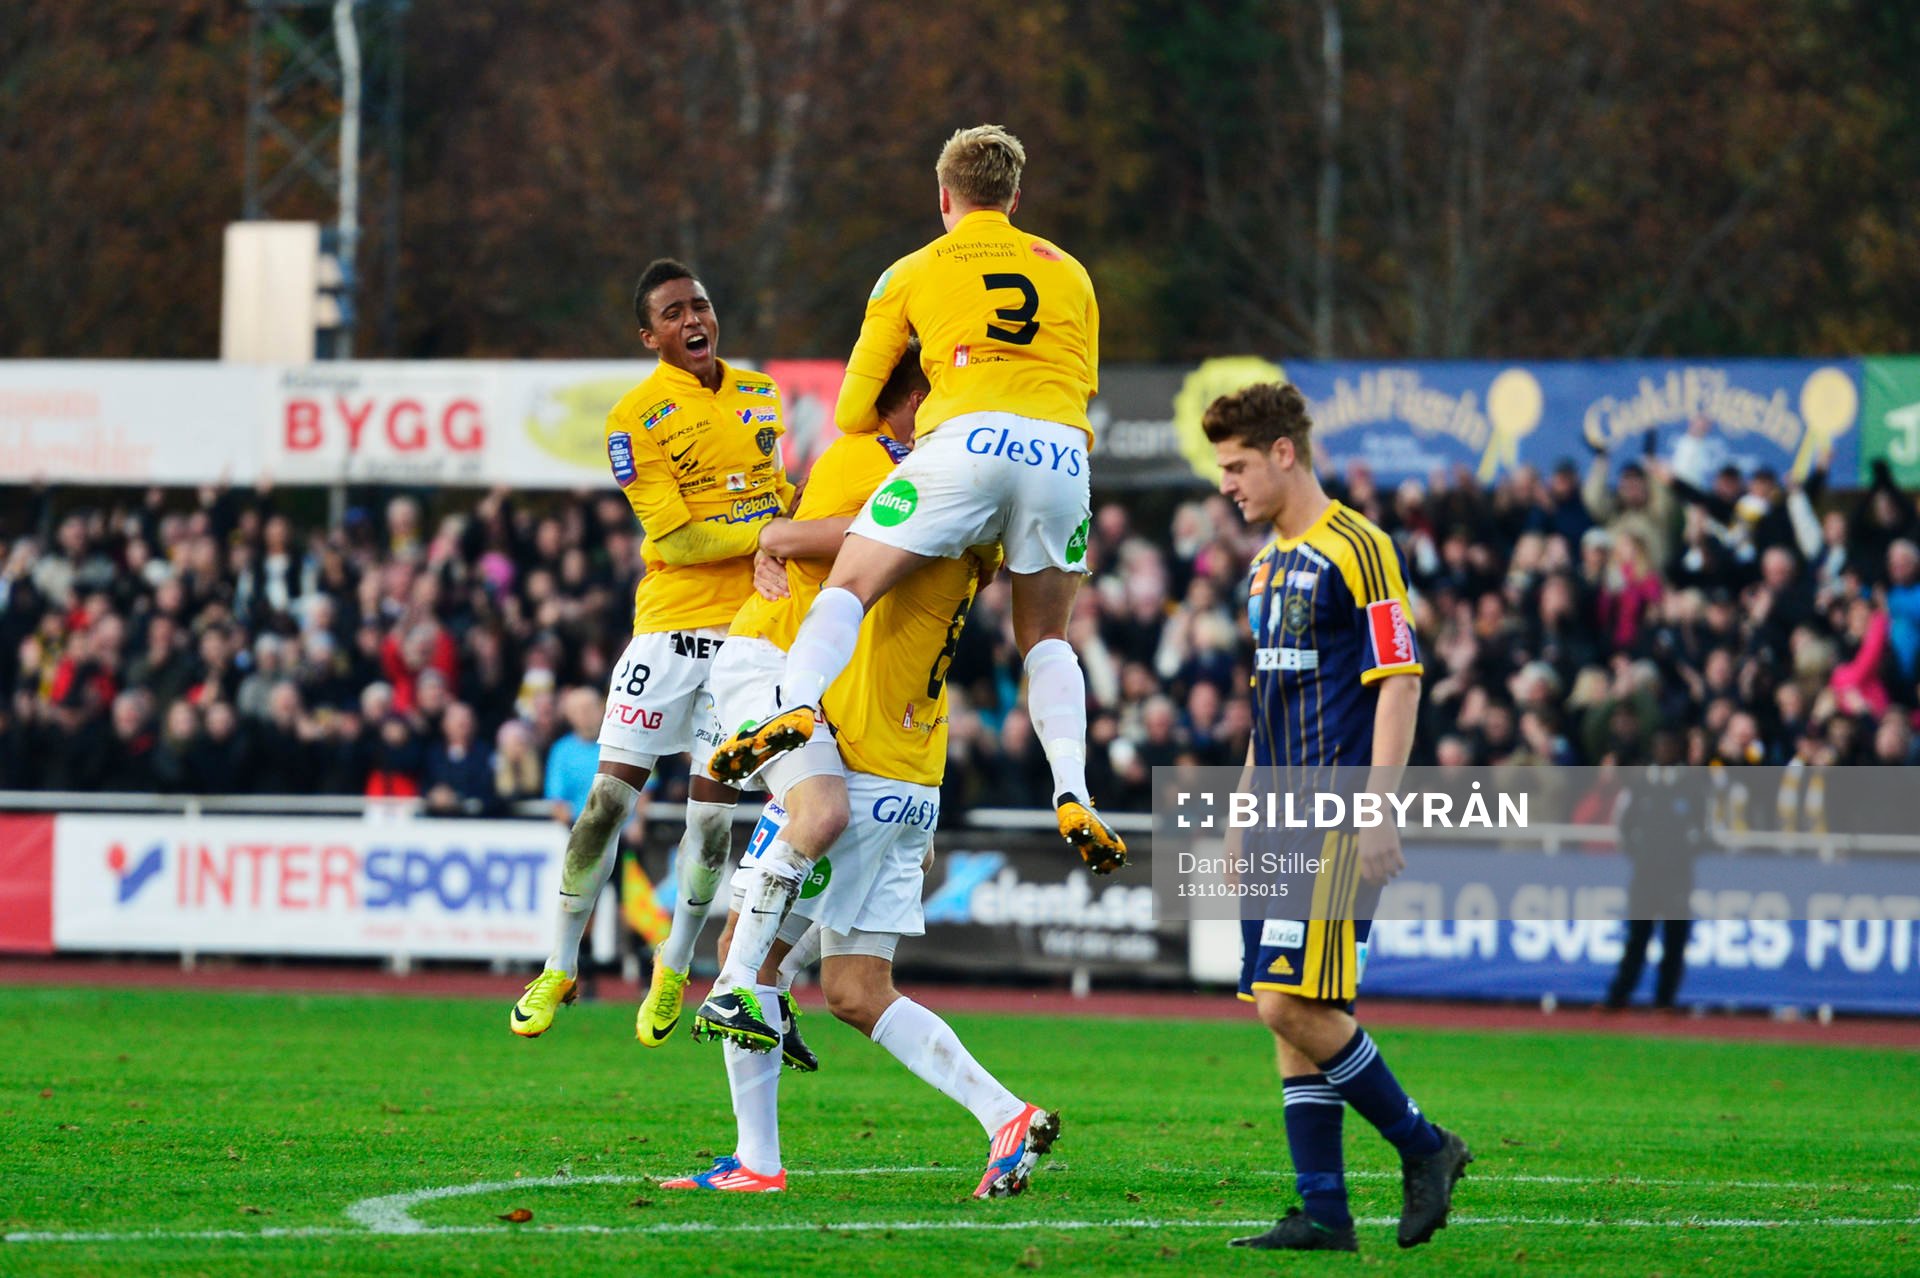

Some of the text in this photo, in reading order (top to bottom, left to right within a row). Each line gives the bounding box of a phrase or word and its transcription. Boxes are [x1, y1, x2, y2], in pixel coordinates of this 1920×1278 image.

[983, 273, 1040, 345] 3
[285, 397, 484, 452] BYGG
[966, 427, 1081, 477] GleSYS
[876, 491, 911, 513] dina
[872, 795, 938, 831] GleSY
[177, 843, 548, 912] INTERSPORT
